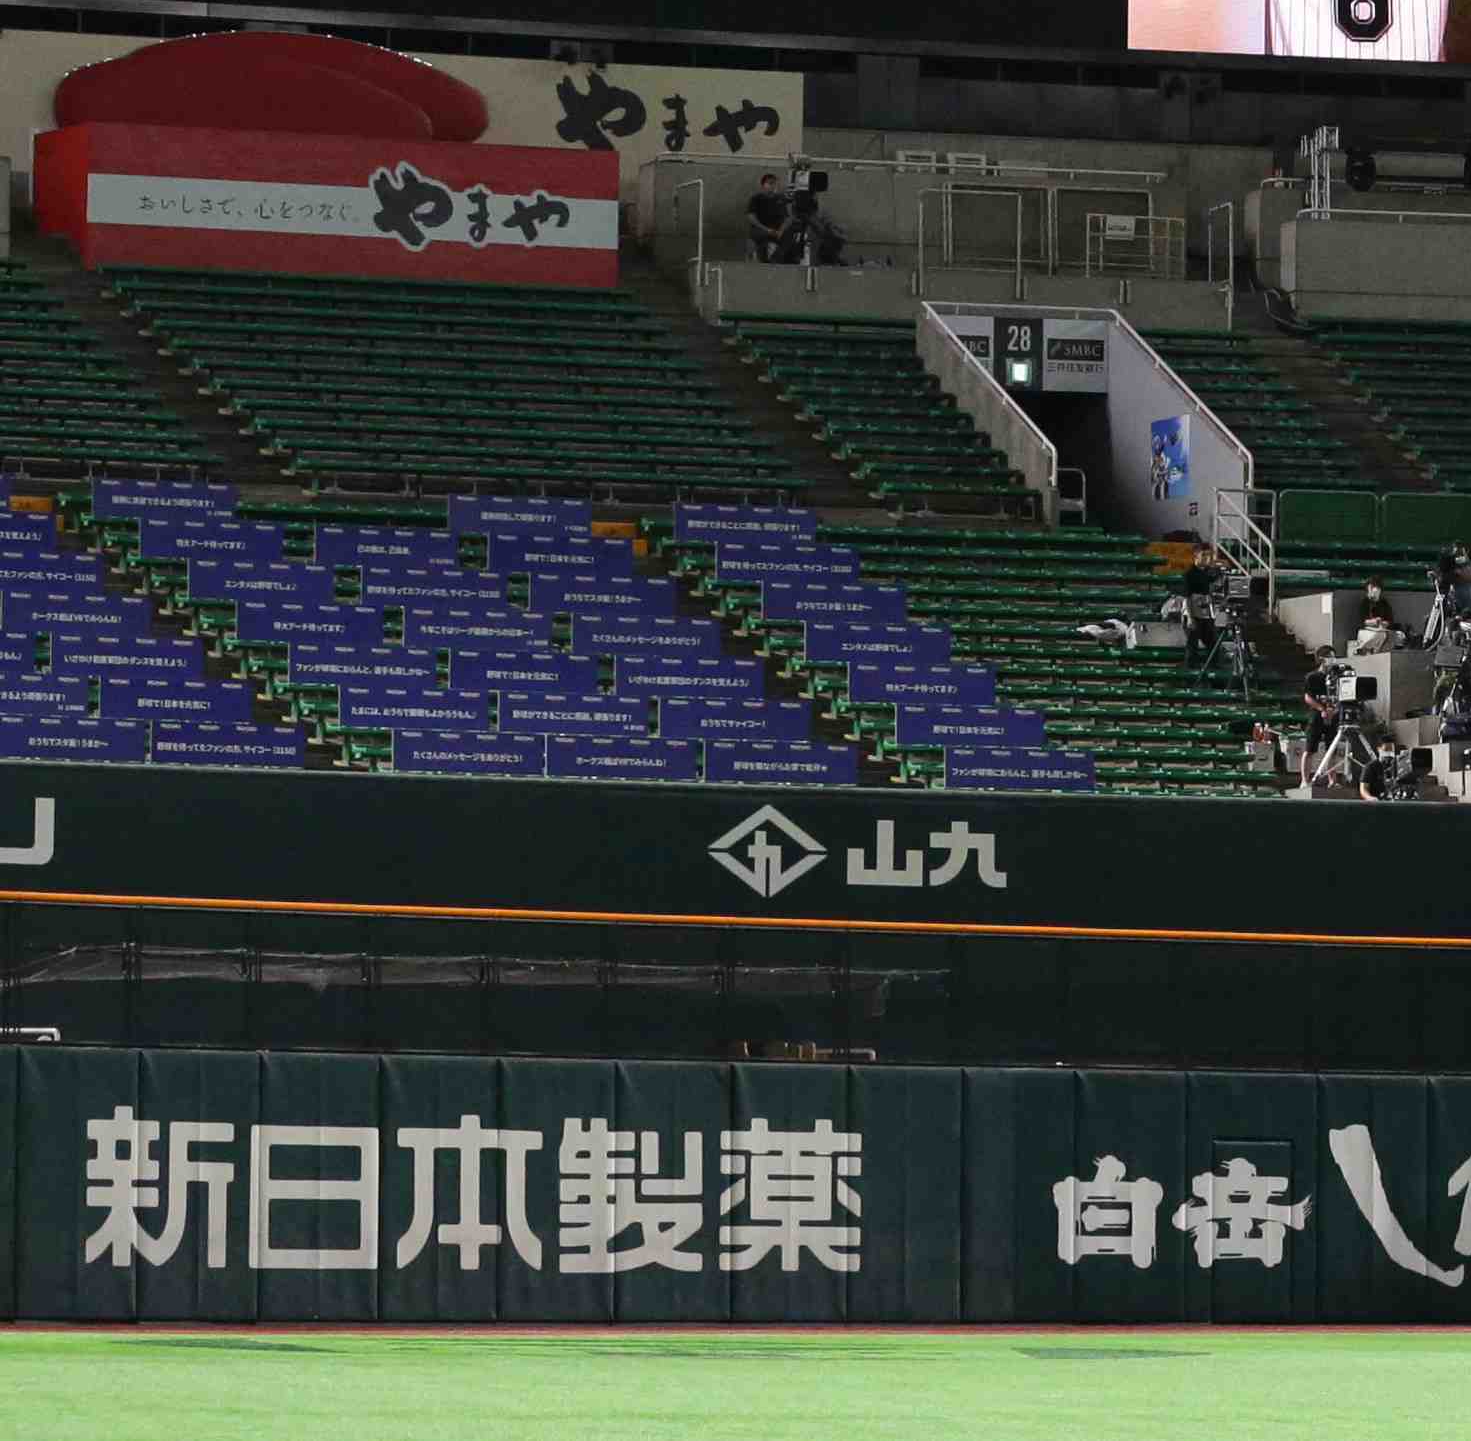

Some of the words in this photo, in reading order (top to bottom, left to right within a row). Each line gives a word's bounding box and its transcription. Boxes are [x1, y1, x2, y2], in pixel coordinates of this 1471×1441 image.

[555, 67, 781, 153] やまや
[370, 164, 570, 250] やまや
[1007, 325, 1032, 352] 28
[1063, 343, 1102, 358] SMBC
[846, 819, 1007, 888] 山九
[85, 1106, 862, 1273] 新日本製薬
